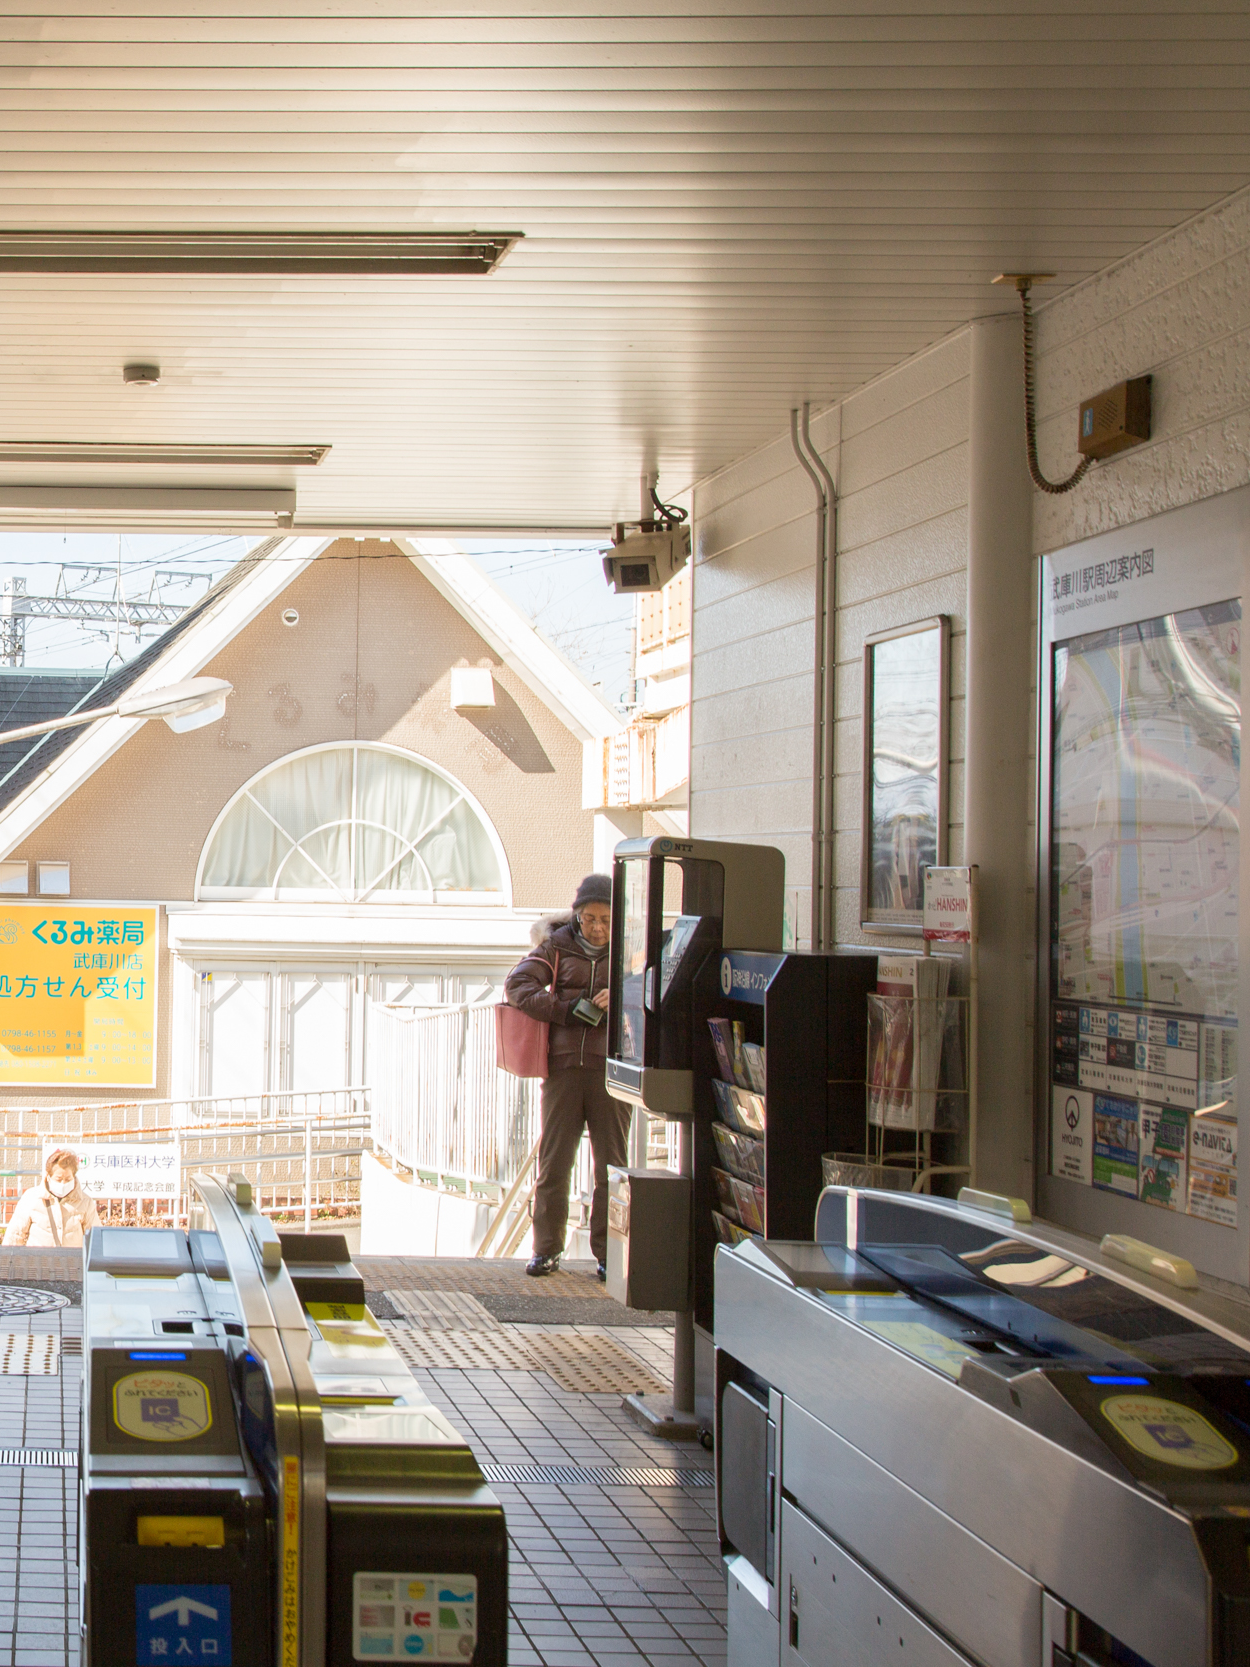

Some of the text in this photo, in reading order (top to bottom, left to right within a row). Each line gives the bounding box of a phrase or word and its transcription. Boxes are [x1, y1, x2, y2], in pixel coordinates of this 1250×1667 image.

[1076, 597, 1094, 610] Station
[1094, 594, 1107, 604] Area
[1107, 589, 1119, 602] Map
[675, 843, 693, 852] NTT
[32, 919, 144, 946] くるみ薬局
[74, 953, 144, 970] 武庫川店
[1, 1029, 57, 1038] 0798-46-1155
[1, 1045, 56, 1053] 0798-46-1157
[1061, 1133, 1083, 1147] HYOJITO
[93, 1154, 175, 1169] 兵庫医科大学
[112, 1181, 175, 1193] 平成記念会館
[124, 1389, 198, 1397] ふれてください
[148, 1405, 171, 1416] IC
[1154, 1429, 1186, 1442] IC
[150, 1637, 218, 1655] 投入口
